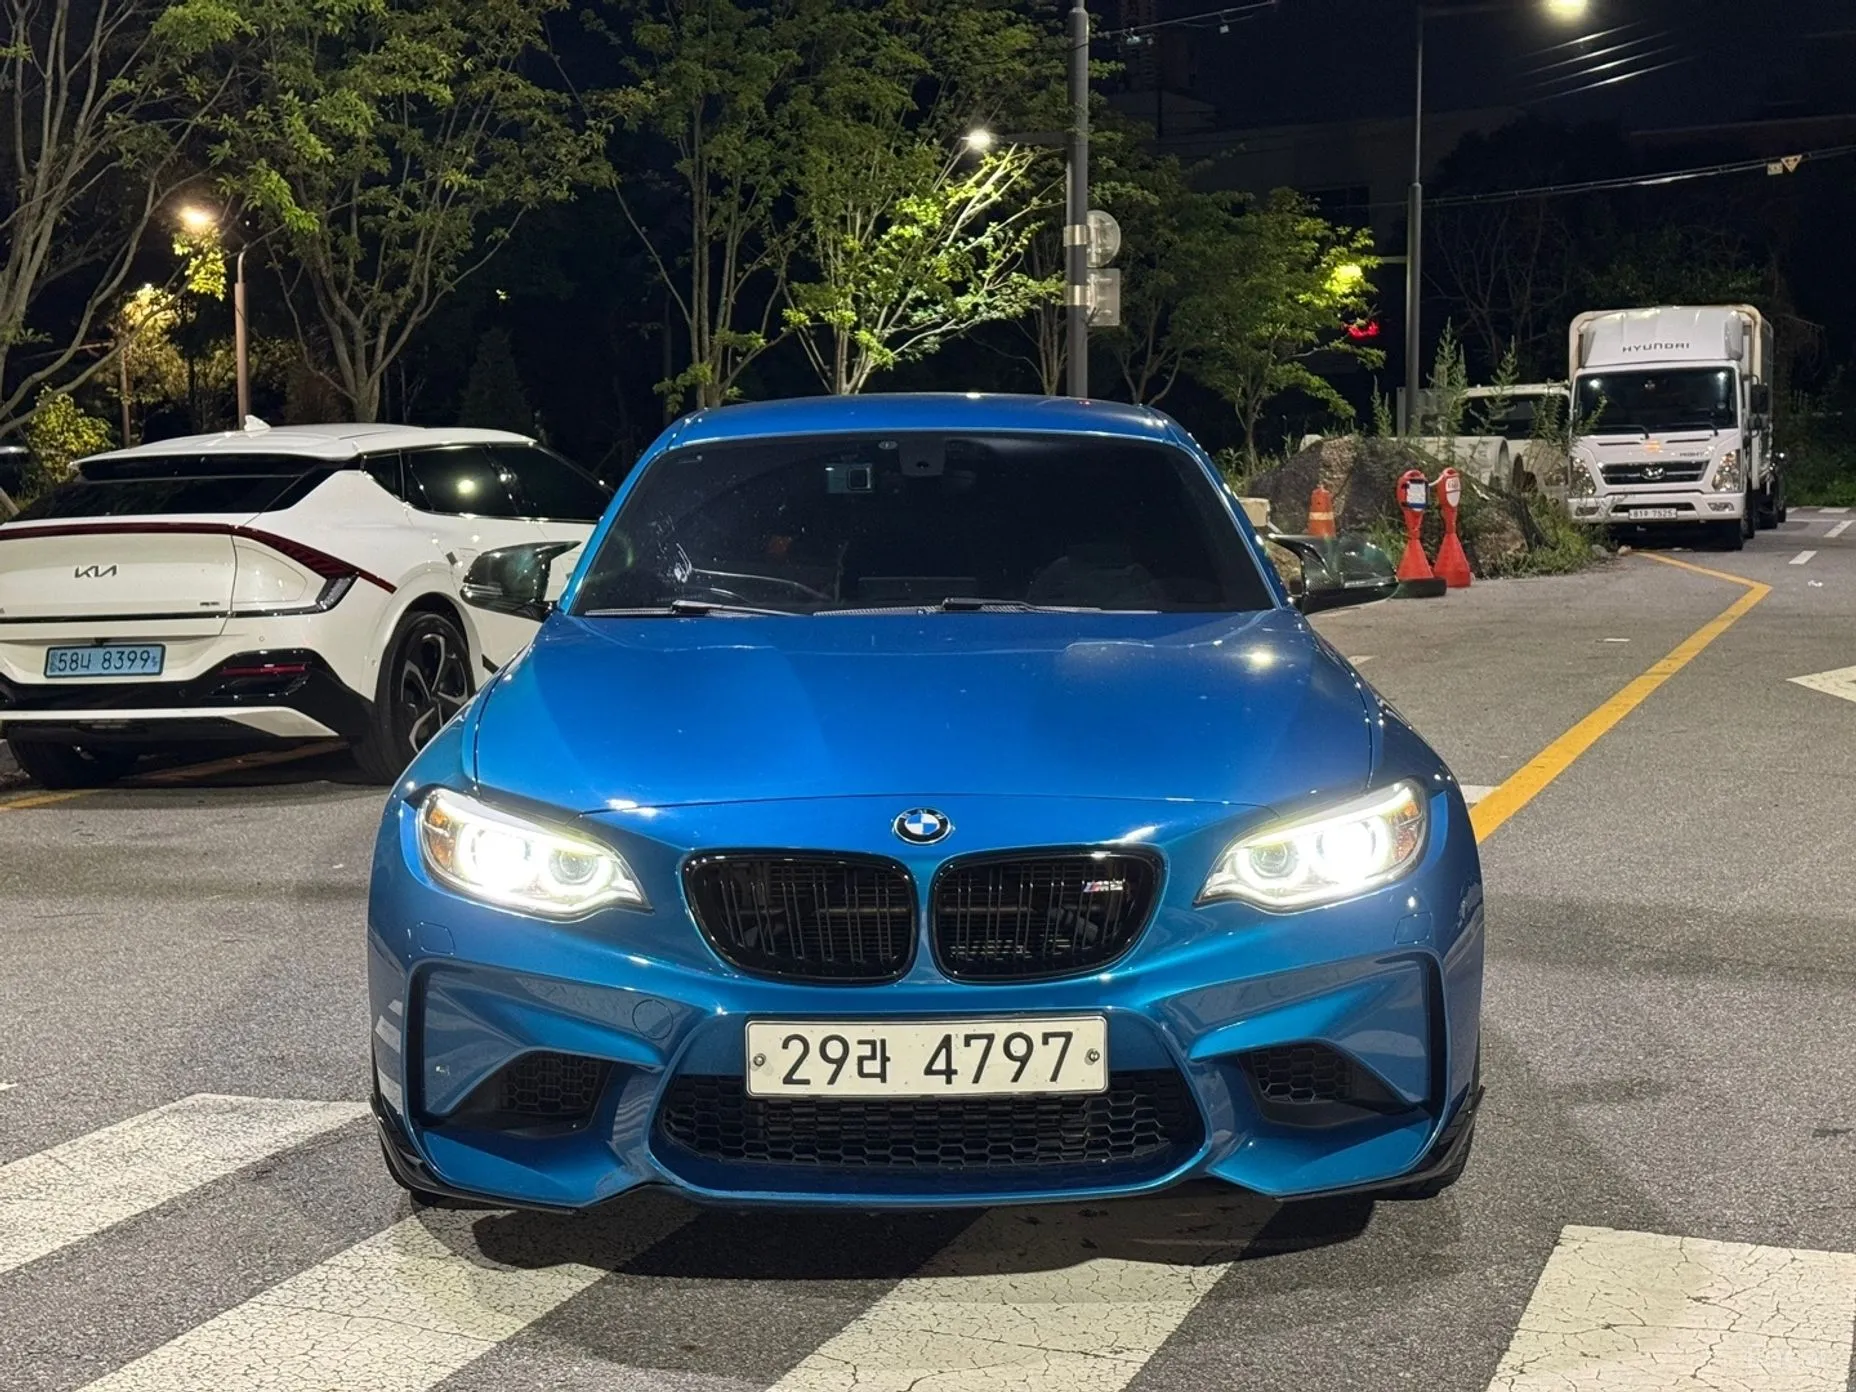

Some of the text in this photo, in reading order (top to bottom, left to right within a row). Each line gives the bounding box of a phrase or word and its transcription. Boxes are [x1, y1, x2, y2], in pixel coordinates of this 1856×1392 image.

[1622, 342, 1690, 353] HYUNDAI
[74, 564, 117, 578] KIA
[101, 649, 151, 671] 8399
[781, 1031, 1074, 1086] 29라 4797
